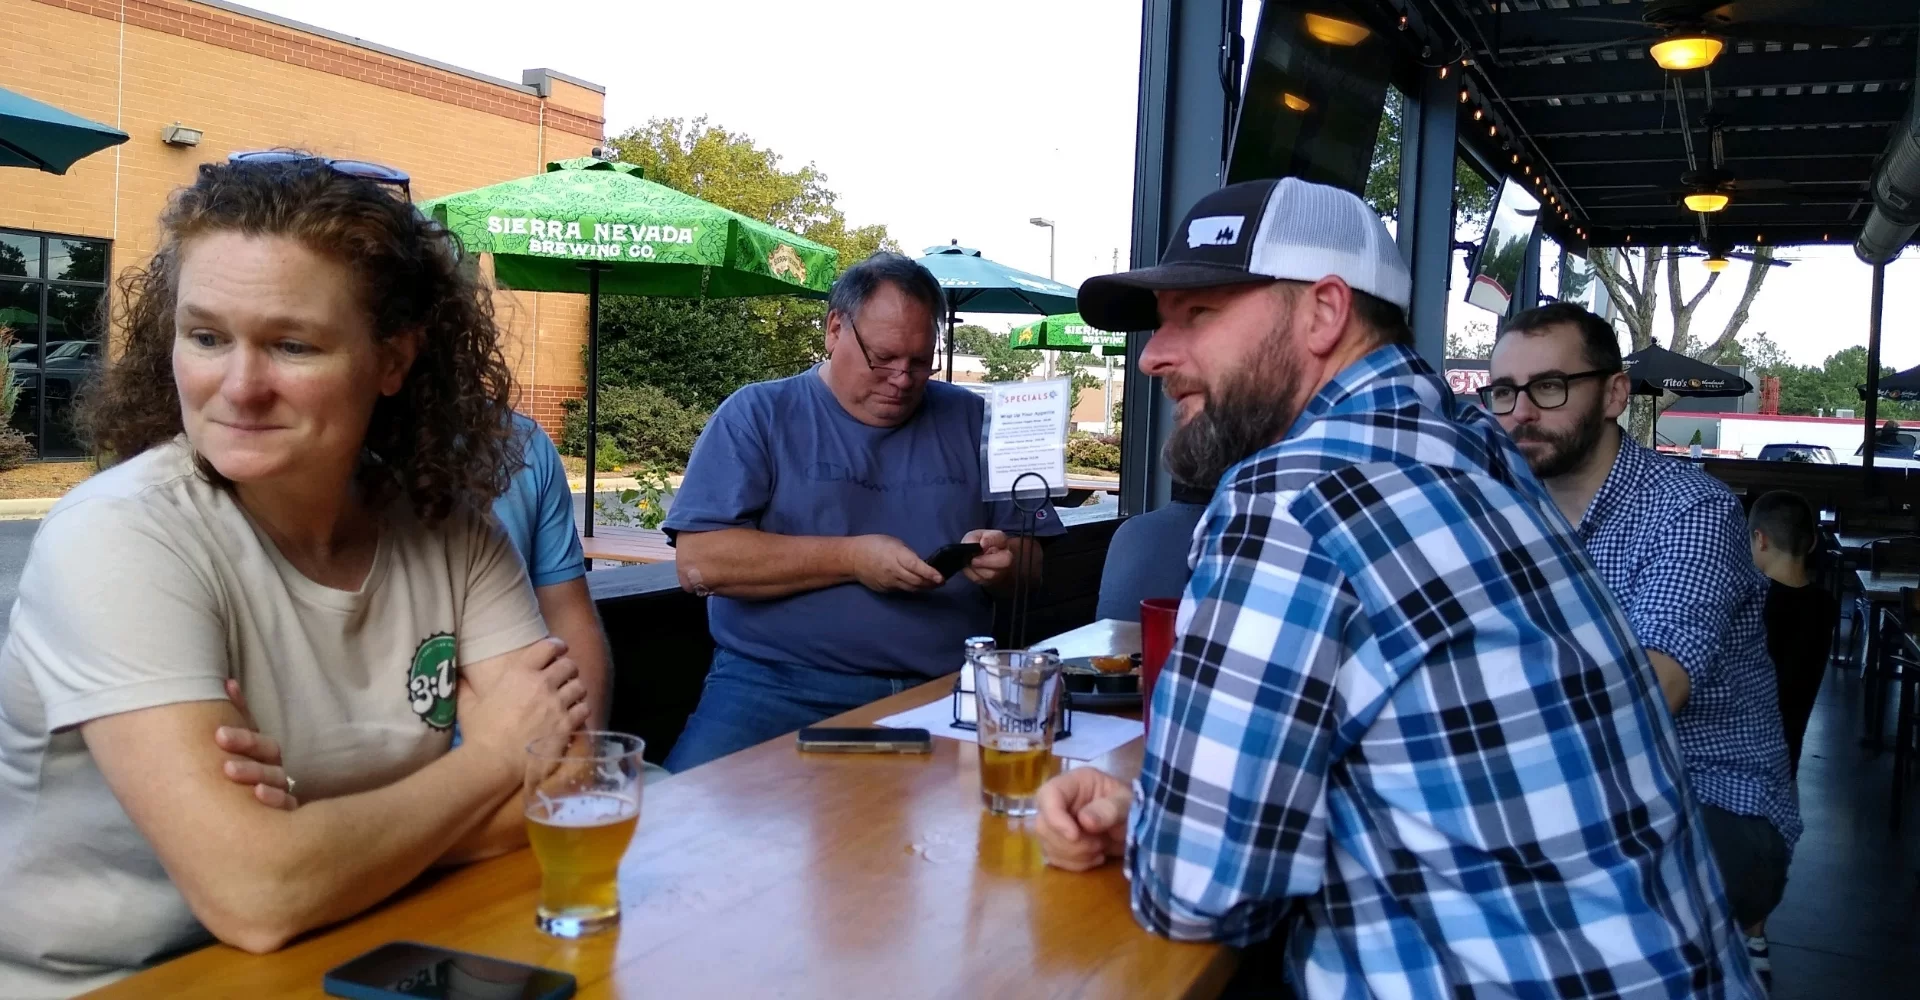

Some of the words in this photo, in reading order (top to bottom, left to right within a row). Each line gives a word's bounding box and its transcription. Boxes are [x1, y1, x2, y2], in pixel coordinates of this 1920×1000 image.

[487, 215, 582, 241] SIERRA
[593, 223, 694, 244] NEVADA
[529, 239, 621, 259] BREWING
[629, 244, 656, 259] CO.
[1082, 336, 1124, 345] BREWING
[1663, 378, 1688, 388] Tito's
[1005, 392, 1048, 404] SPECIALS
[806, 461, 968, 497] Chamion
[410, 656, 456, 714] 3:1
